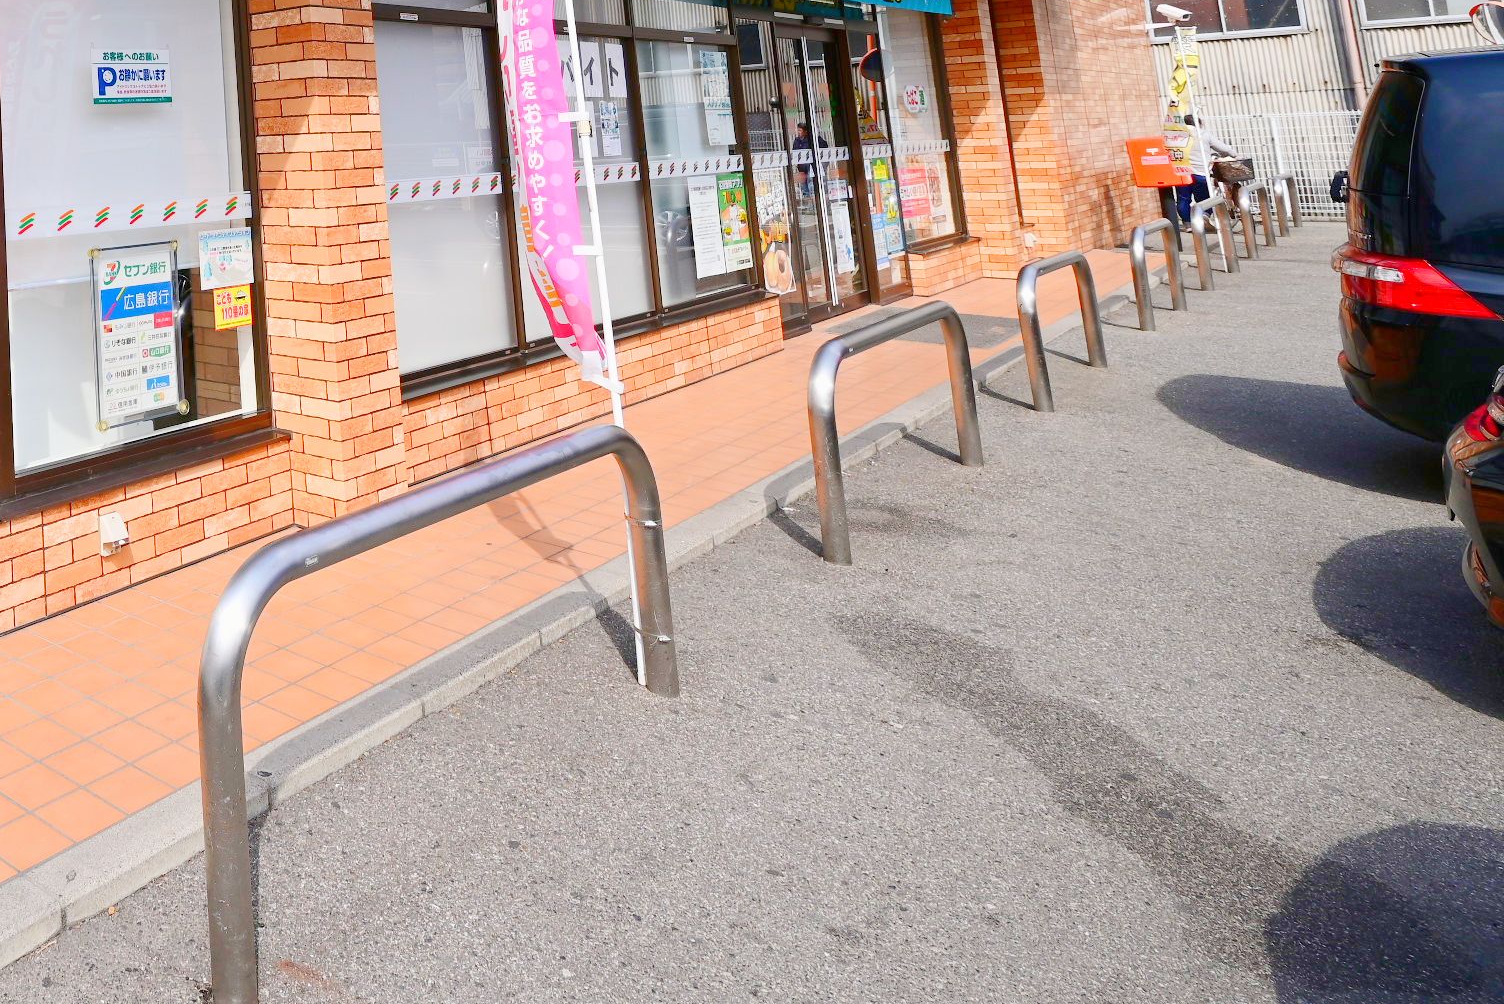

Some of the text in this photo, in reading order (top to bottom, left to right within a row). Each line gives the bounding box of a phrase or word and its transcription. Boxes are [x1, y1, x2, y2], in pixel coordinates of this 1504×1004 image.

[102, 51, 159, 62] お客様へのお願い
[98, 67, 117, 96] P
[118, 68, 166, 82] お静かに願います
[124, 261, 167, 277] セブン銀行
[123, 289, 170, 311] 広島銀行
[216, 291, 233, 306] こども
[111, 336, 137, 348] りそな銀行
[114, 367, 138, 379] 中国銀行
